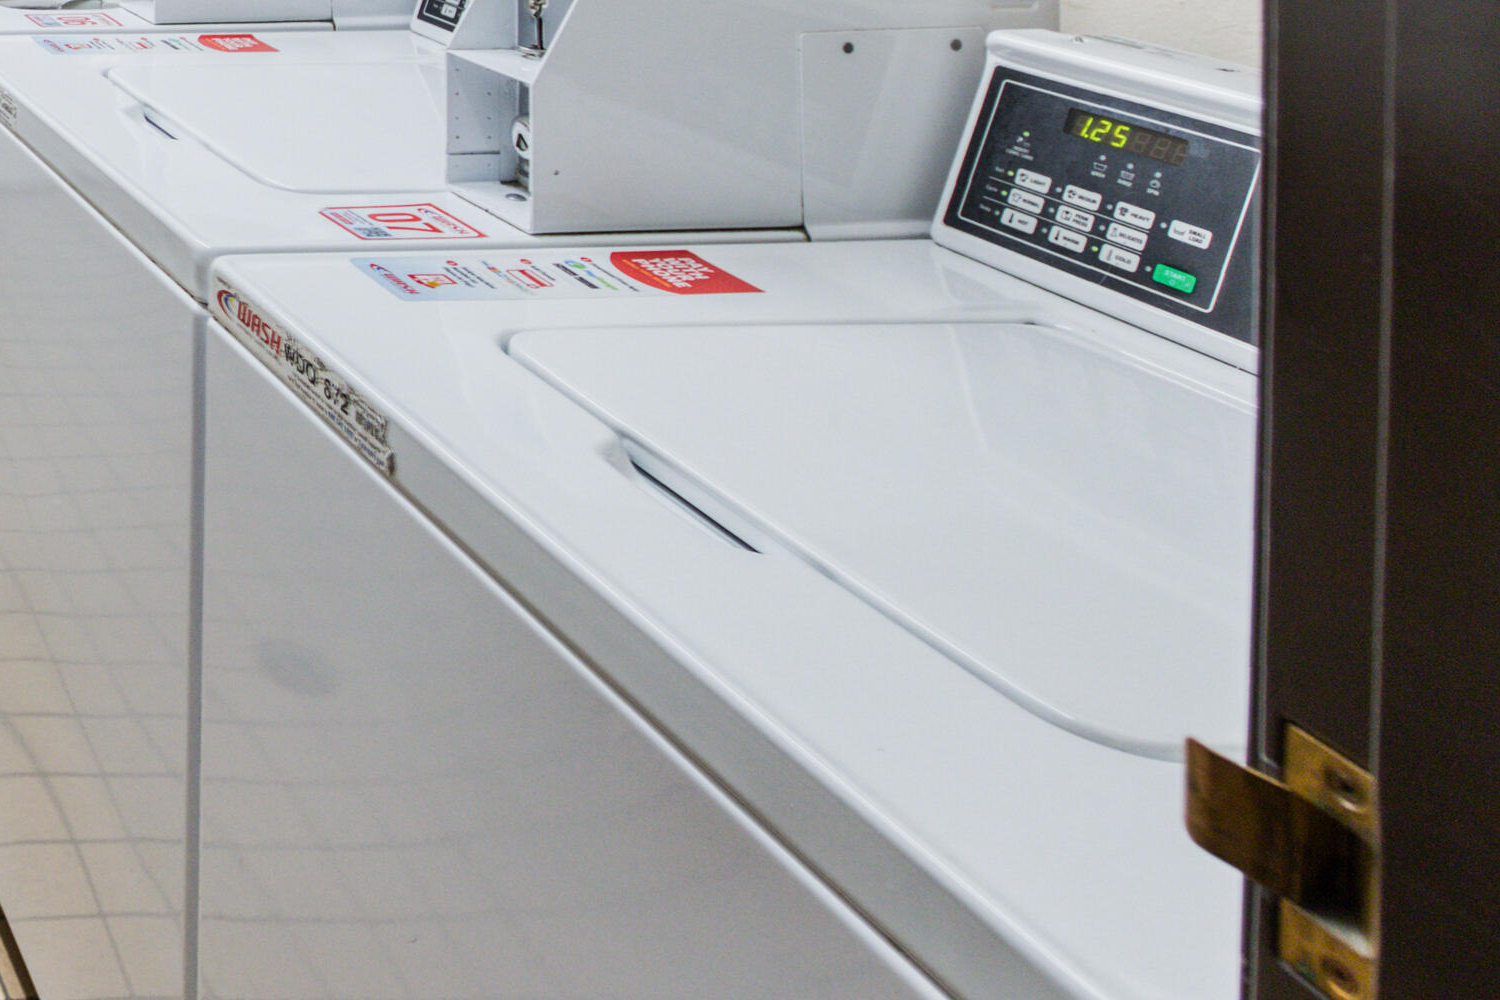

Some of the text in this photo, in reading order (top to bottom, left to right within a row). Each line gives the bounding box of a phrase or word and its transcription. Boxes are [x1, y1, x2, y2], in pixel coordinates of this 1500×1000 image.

[1079, 117, 1131, 148] 1.25
[367, 213, 444, 233] 07
[1075, 213, 1089, 222] PERM
[1130, 212, 1150, 222] HEAVY
[1188, 229, 1206, 239] SMALL
[1188, 235, 1203, 245] LOAD
[677, 257, 715, 273] PAY
[1114, 254, 1132, 265] COLD
[631, 258, 692, 288] PHONE
[648, 258, 700, 281] YOUR
[663, 257, 710, 280] WITH
[1164, 269, 1187, 281] START
[237, 301, 281, 354] WASH
